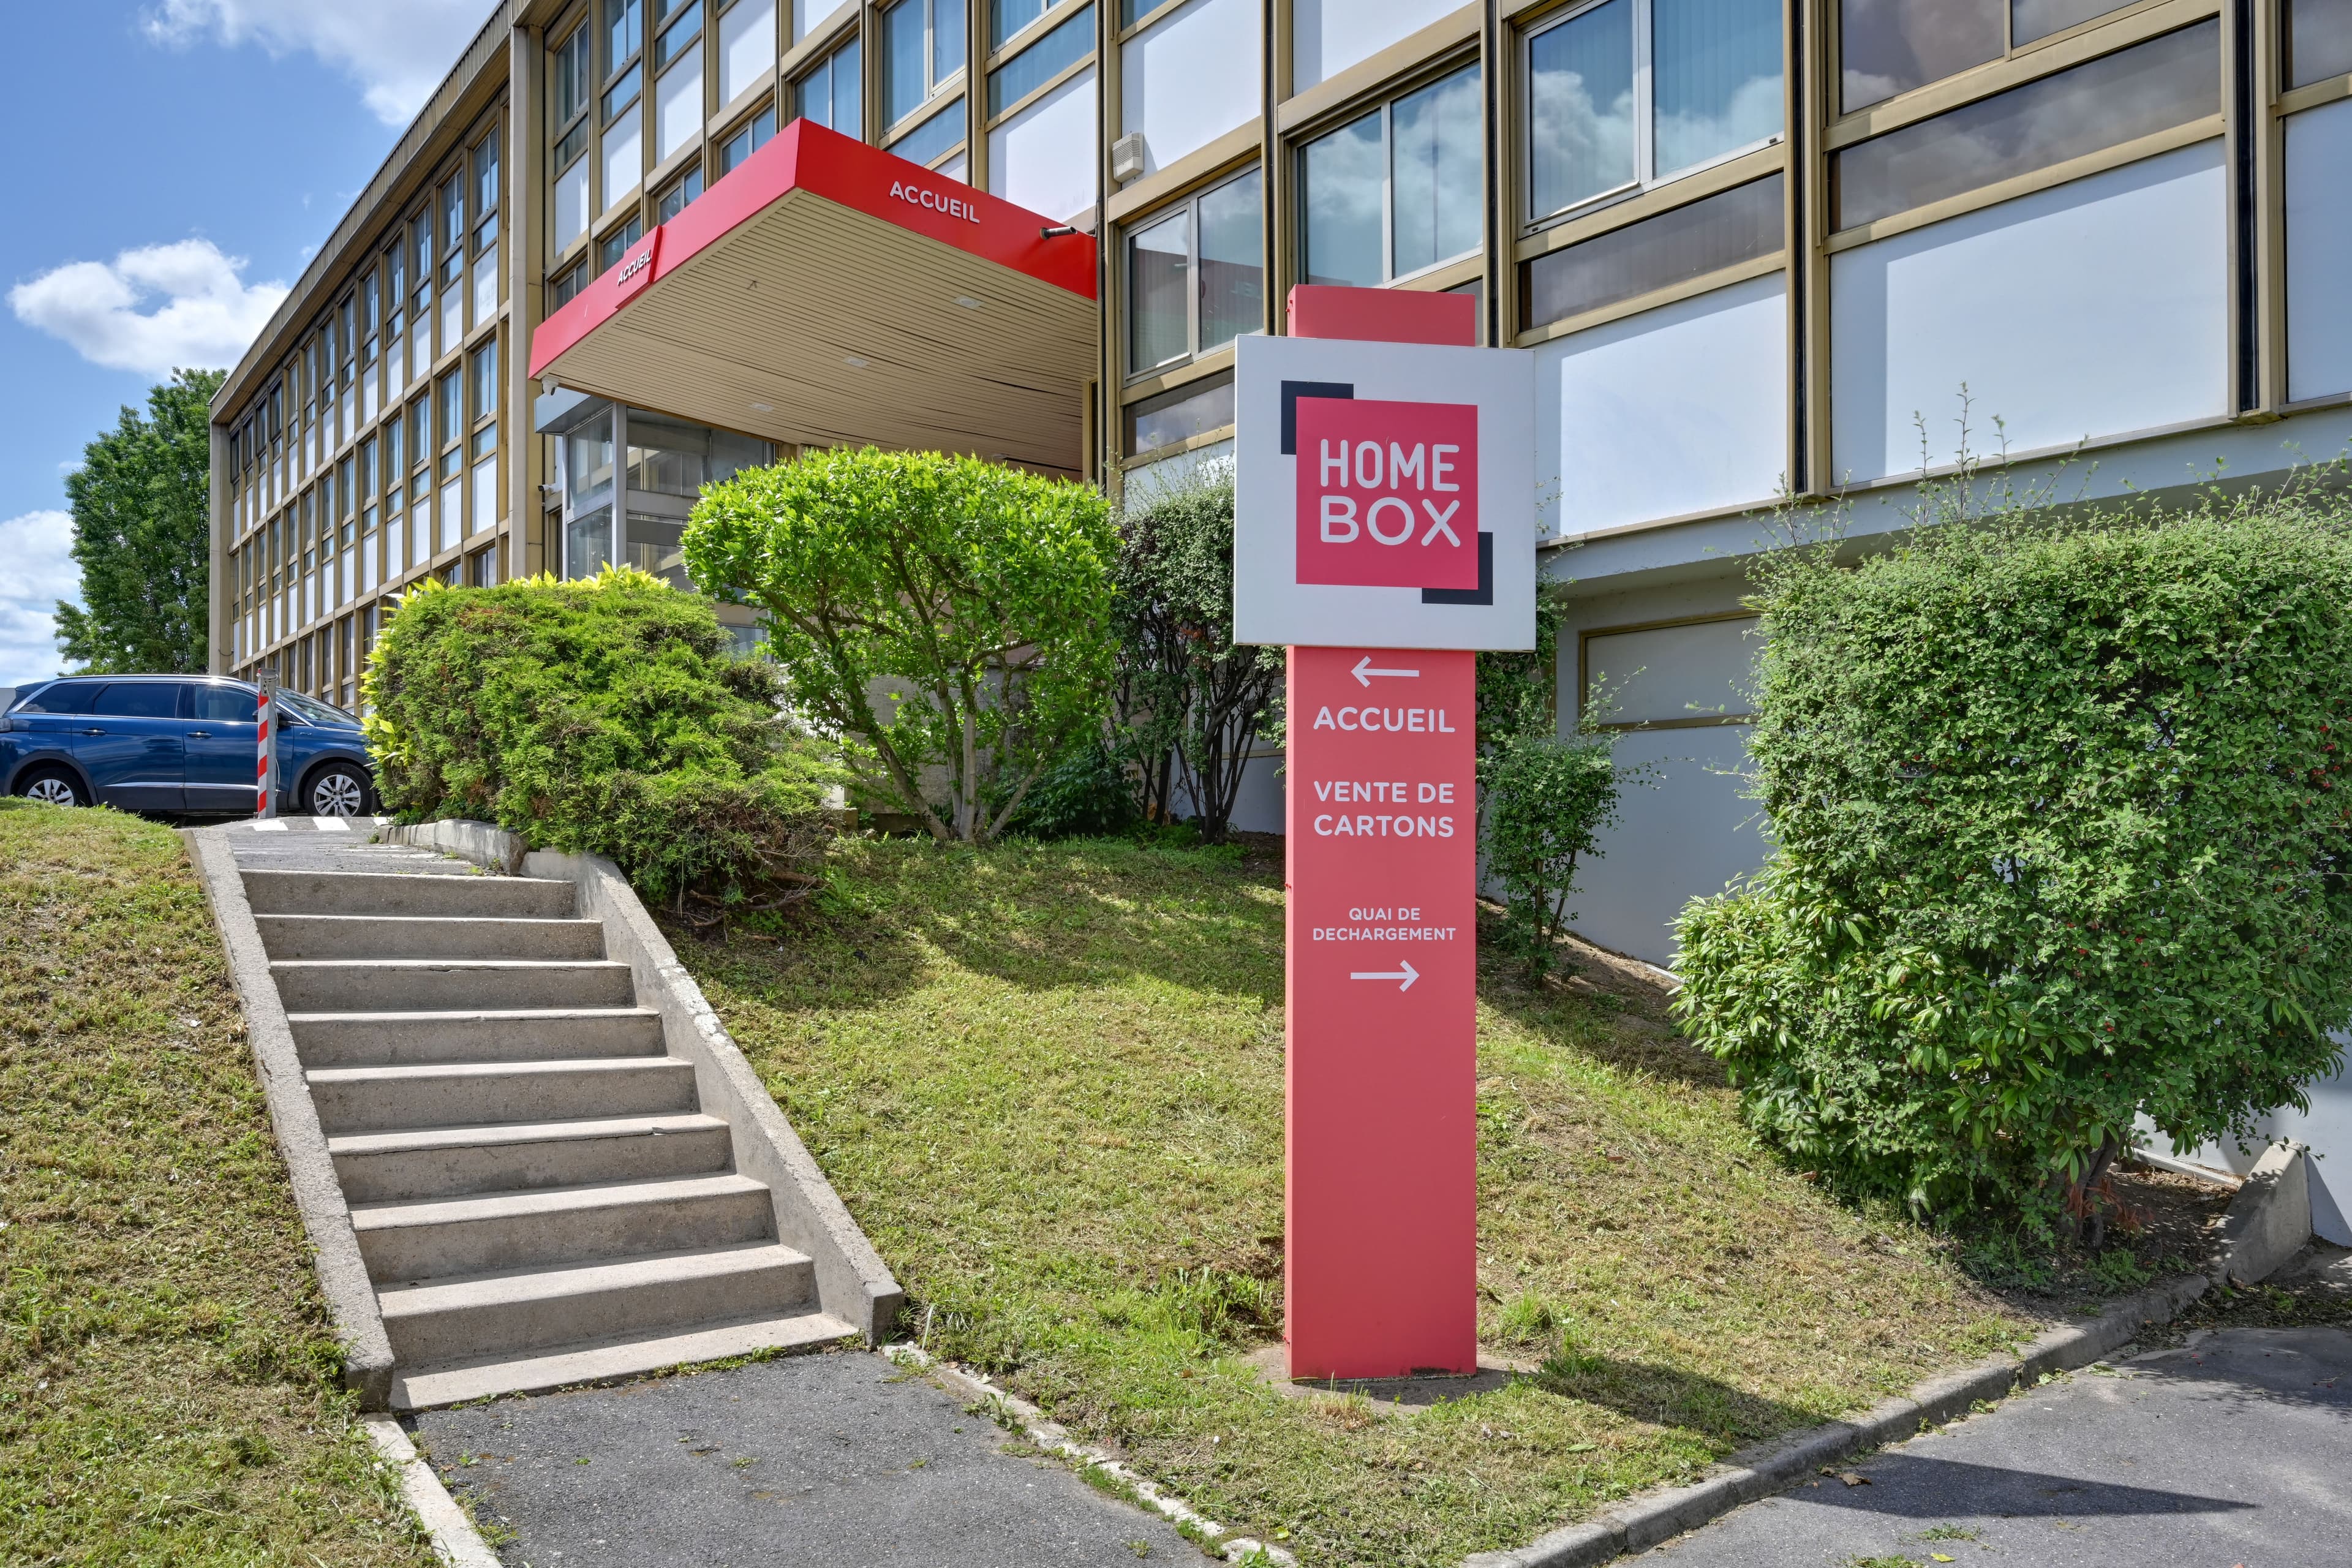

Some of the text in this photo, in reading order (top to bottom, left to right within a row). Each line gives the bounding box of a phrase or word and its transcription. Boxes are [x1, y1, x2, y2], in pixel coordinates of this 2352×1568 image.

[889, 181, 980, 224] ACCUEIL
[617, 248, 651, 285] ACCUEIL
[1321, 439, 1460, 491] HOME
[1321, 496, 1460, 547] BOX
[1313, 706, 1455, 733] ACCUEIL
[1314, 781, 1454, 803] VENTE DE
[1314, 815, 1453, 837] CARTONS
[1349, 908, 1420, 921] QUAI DE
[1313, 927, 1456, 941] DECHARGEMENT
